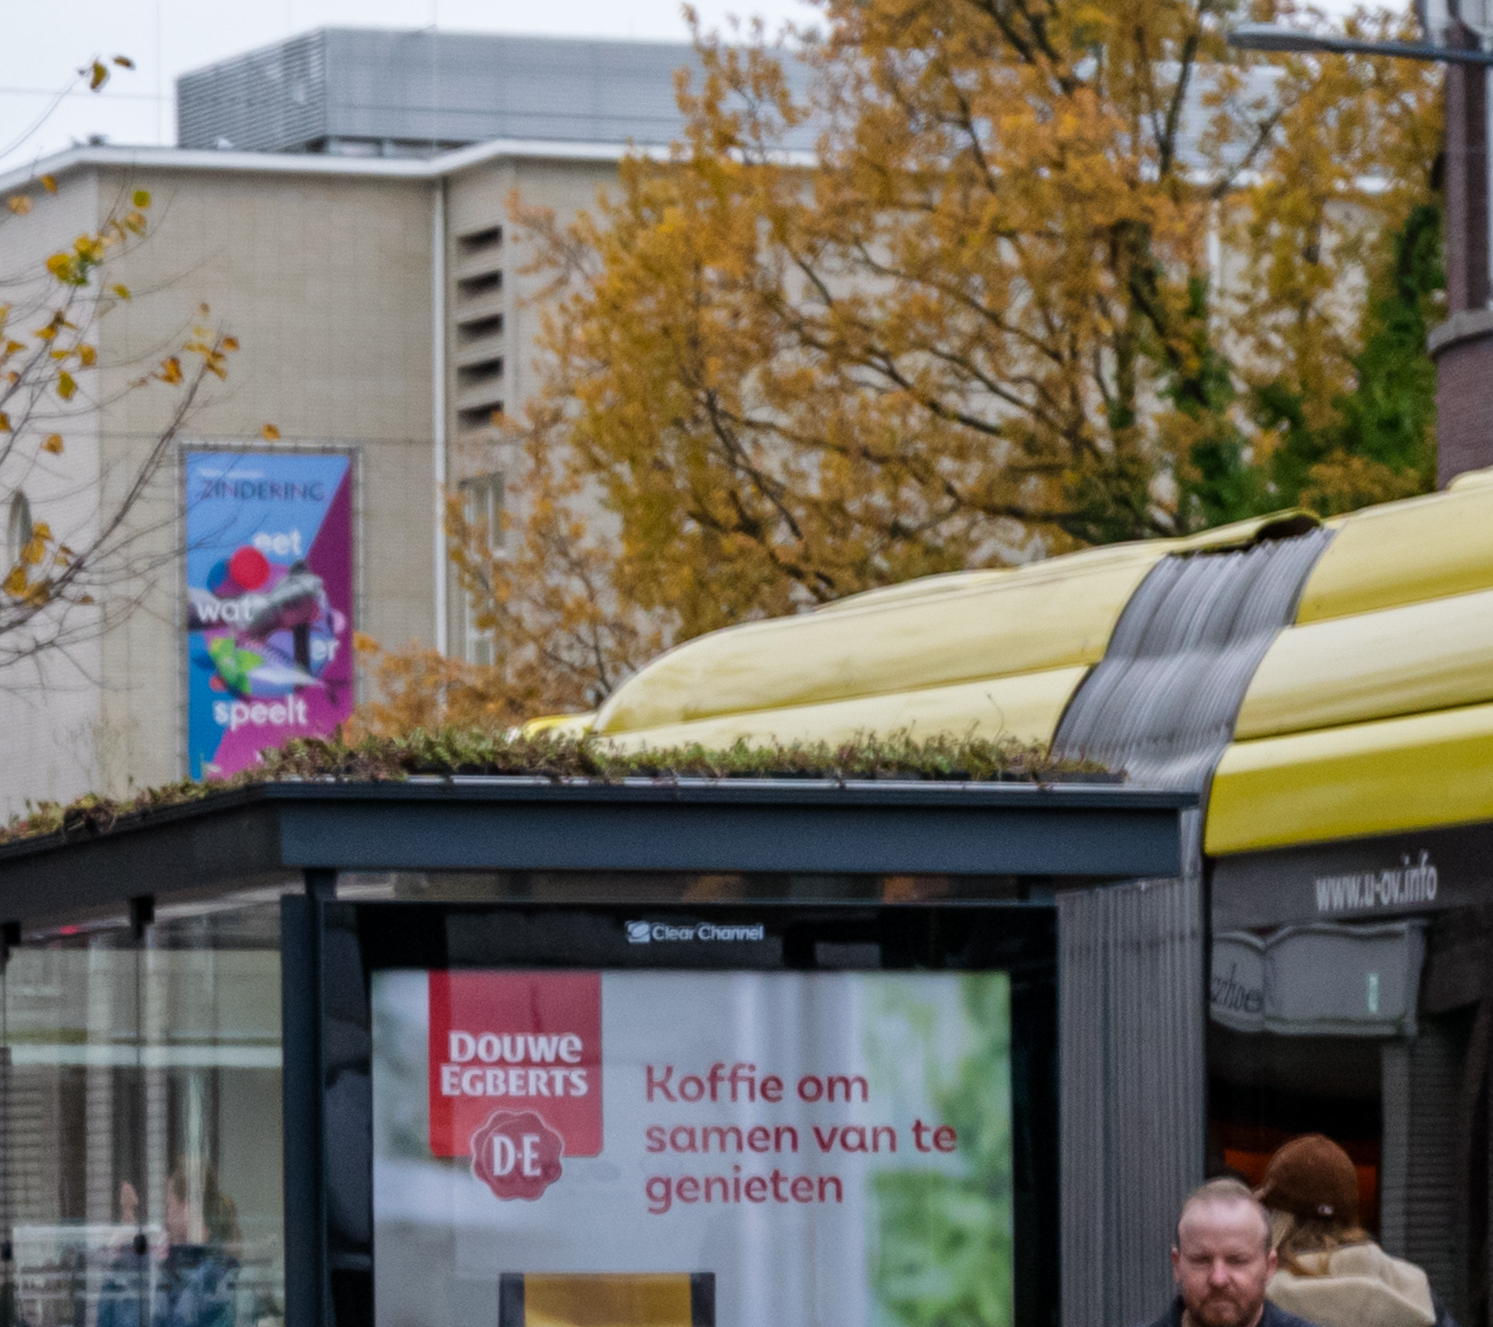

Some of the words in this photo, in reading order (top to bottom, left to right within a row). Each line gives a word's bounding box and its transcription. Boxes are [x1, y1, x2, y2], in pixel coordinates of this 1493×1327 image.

[203, 480, 325, 502] ZINDERING
[213, 692, 307, 733] speelt
[1315, 849, 1438, 912] www.u-ov.info
[652, 924, 695, 942] Clear
[697, 923, 765, 942] Channel
[440, 1064, 590, 1098] EGBERTS
[645, 1061, 784, 1103] Koffie
[797, 1074, 869, 1103] om
[645, 1124, 799, 1153] samen
[812, 1124, 898, 1153] van
[912, 1118, 958, 1153] te
[645, 1164, 844, 1215] genieten
